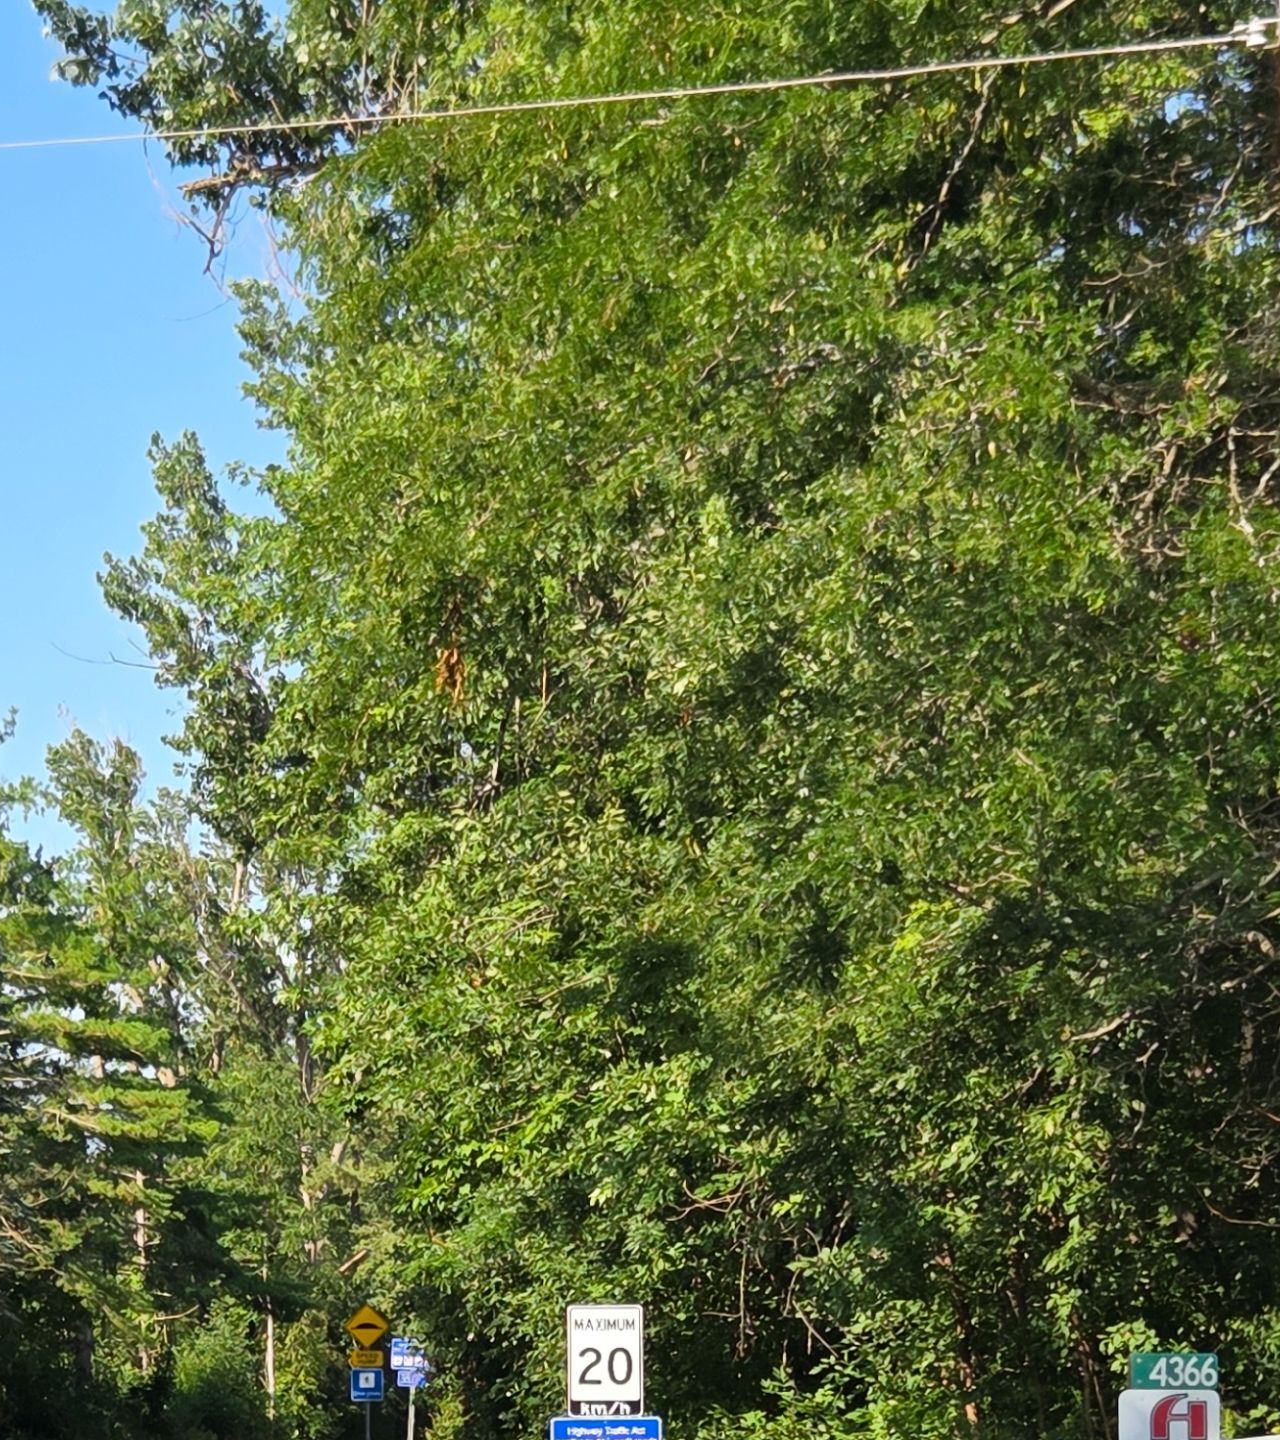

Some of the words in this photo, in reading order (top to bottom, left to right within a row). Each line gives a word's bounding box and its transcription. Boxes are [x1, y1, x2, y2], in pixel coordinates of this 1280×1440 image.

[574, 1318, 635, 1331] MAXIMUM
[578, 1347, 633, 1385] 20
[1148, 1356, 1218, 1387] 4366
[580, 1402, 631, 1415] km/h
